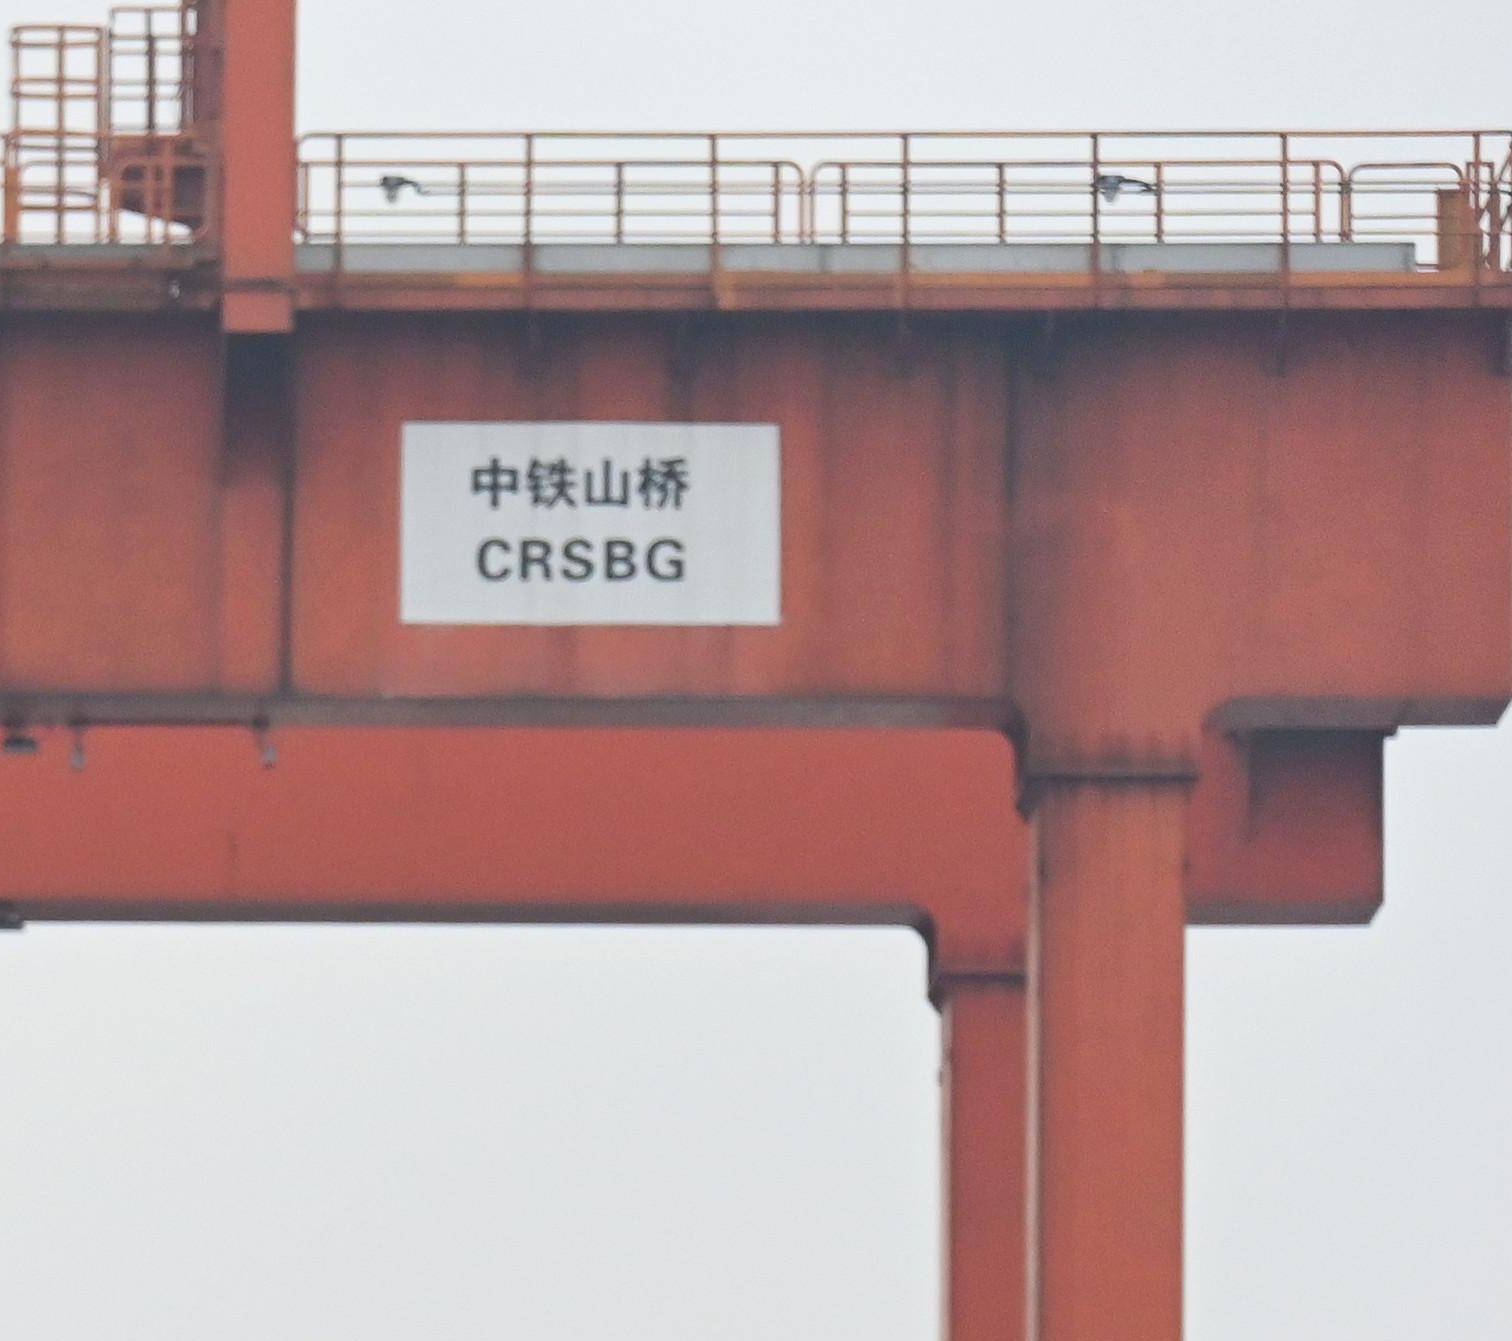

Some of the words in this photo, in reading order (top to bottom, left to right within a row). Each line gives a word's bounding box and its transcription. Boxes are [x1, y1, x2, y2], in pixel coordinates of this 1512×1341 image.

[470, 456, 690, 512] 中铁山桥
[475, 538, 688, 584] CRSBG
